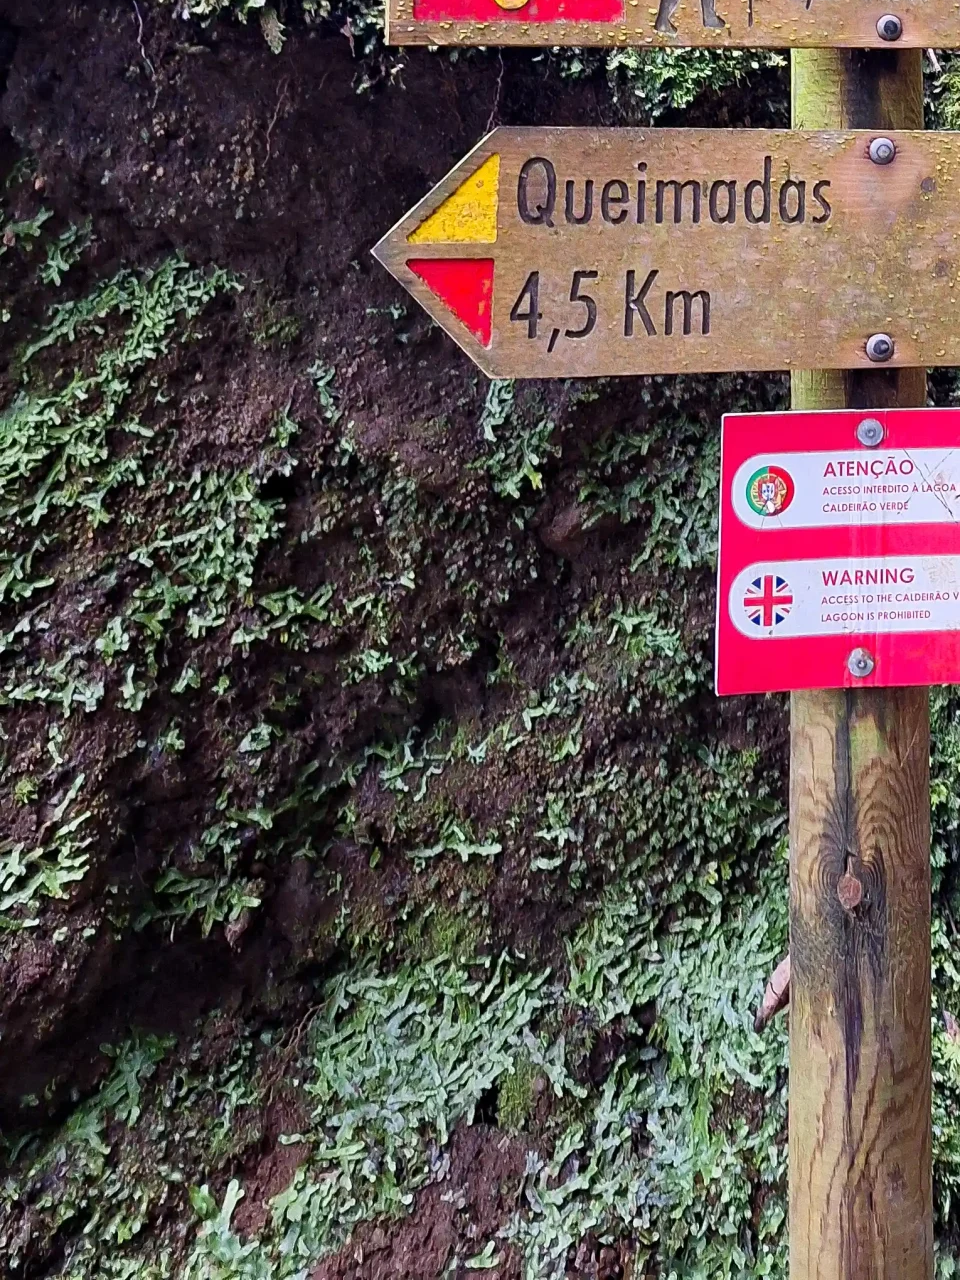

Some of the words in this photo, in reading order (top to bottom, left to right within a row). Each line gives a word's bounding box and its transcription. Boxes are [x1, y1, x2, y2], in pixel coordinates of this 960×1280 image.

[517, 156, 832, 227] Queimadas
[510, 270, 599, 354] 4,5
[623, 269, 712, 337] Km
[823, 456, 914, 479] ATENÇÃO
[822, 485, 860, 496] ACESSO
[863, 484, 909, 494] INTERDITO
[921, 483, 956, 493] LAGOA
[822, 500, 877, 513] CALDEIRÃO
[879, 501, 909, 511] VERDE
[822, 567, 915, 587] WARNING
[821, 594, 859, 605] ACCESS
[862, 594, 873, 604] TO
[876, 593, 892, 603] THE
[895, 590, 950, 602] CALDEIRÃO
[821, 612, 864, 623] LAGOON
[867, 611, 875, 621] IS
[877, 610, 931, 620] PROHIBITED
